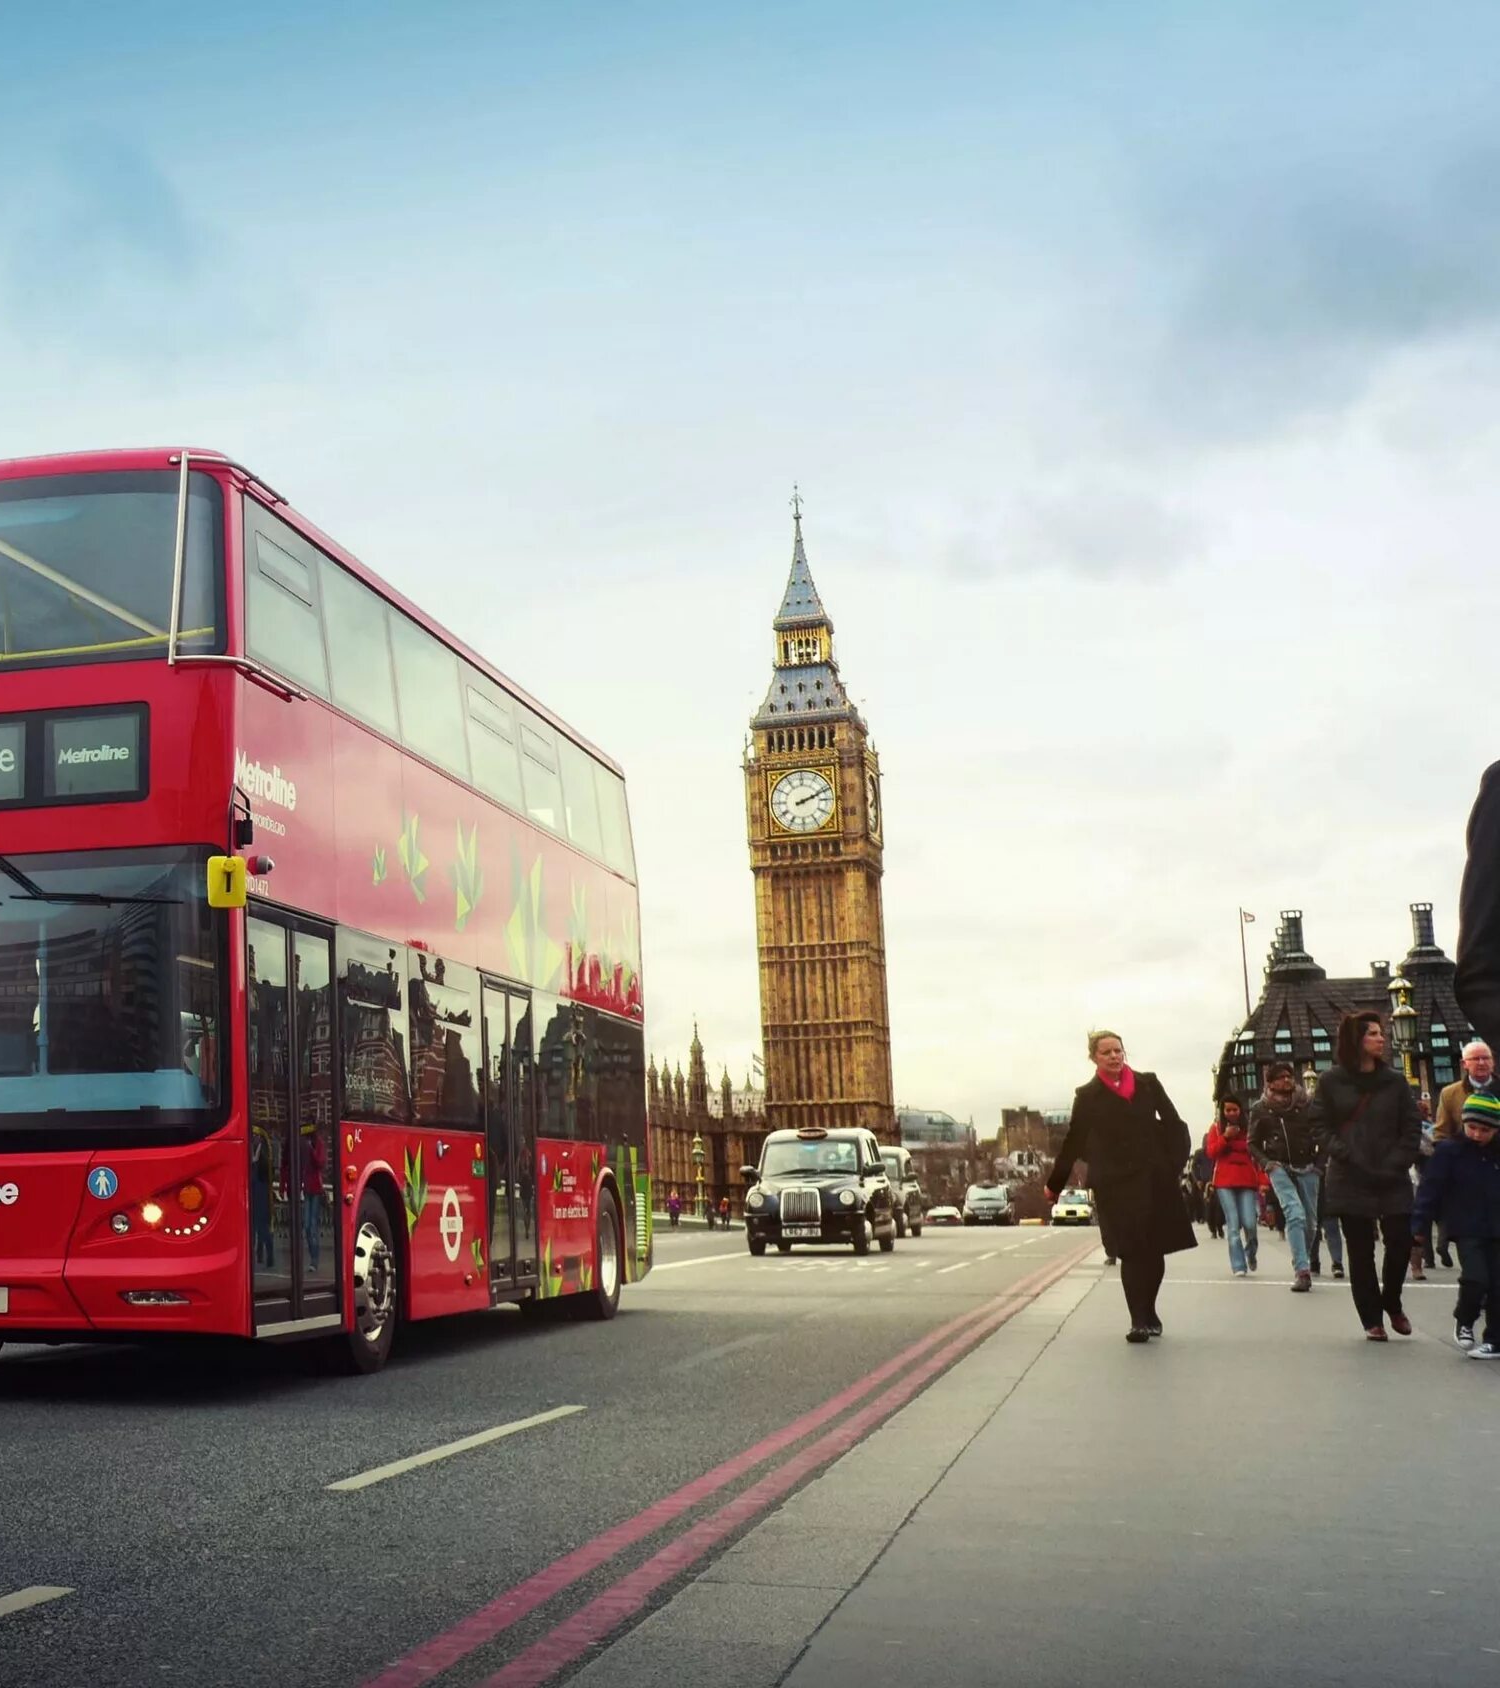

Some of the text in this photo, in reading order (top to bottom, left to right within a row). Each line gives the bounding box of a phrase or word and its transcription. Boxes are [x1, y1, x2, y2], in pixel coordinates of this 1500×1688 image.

[57, 744, 130, 765] Metroline
[234, 747, 297, 811] Metroline
[354, 1128, 362, 1143] AC
